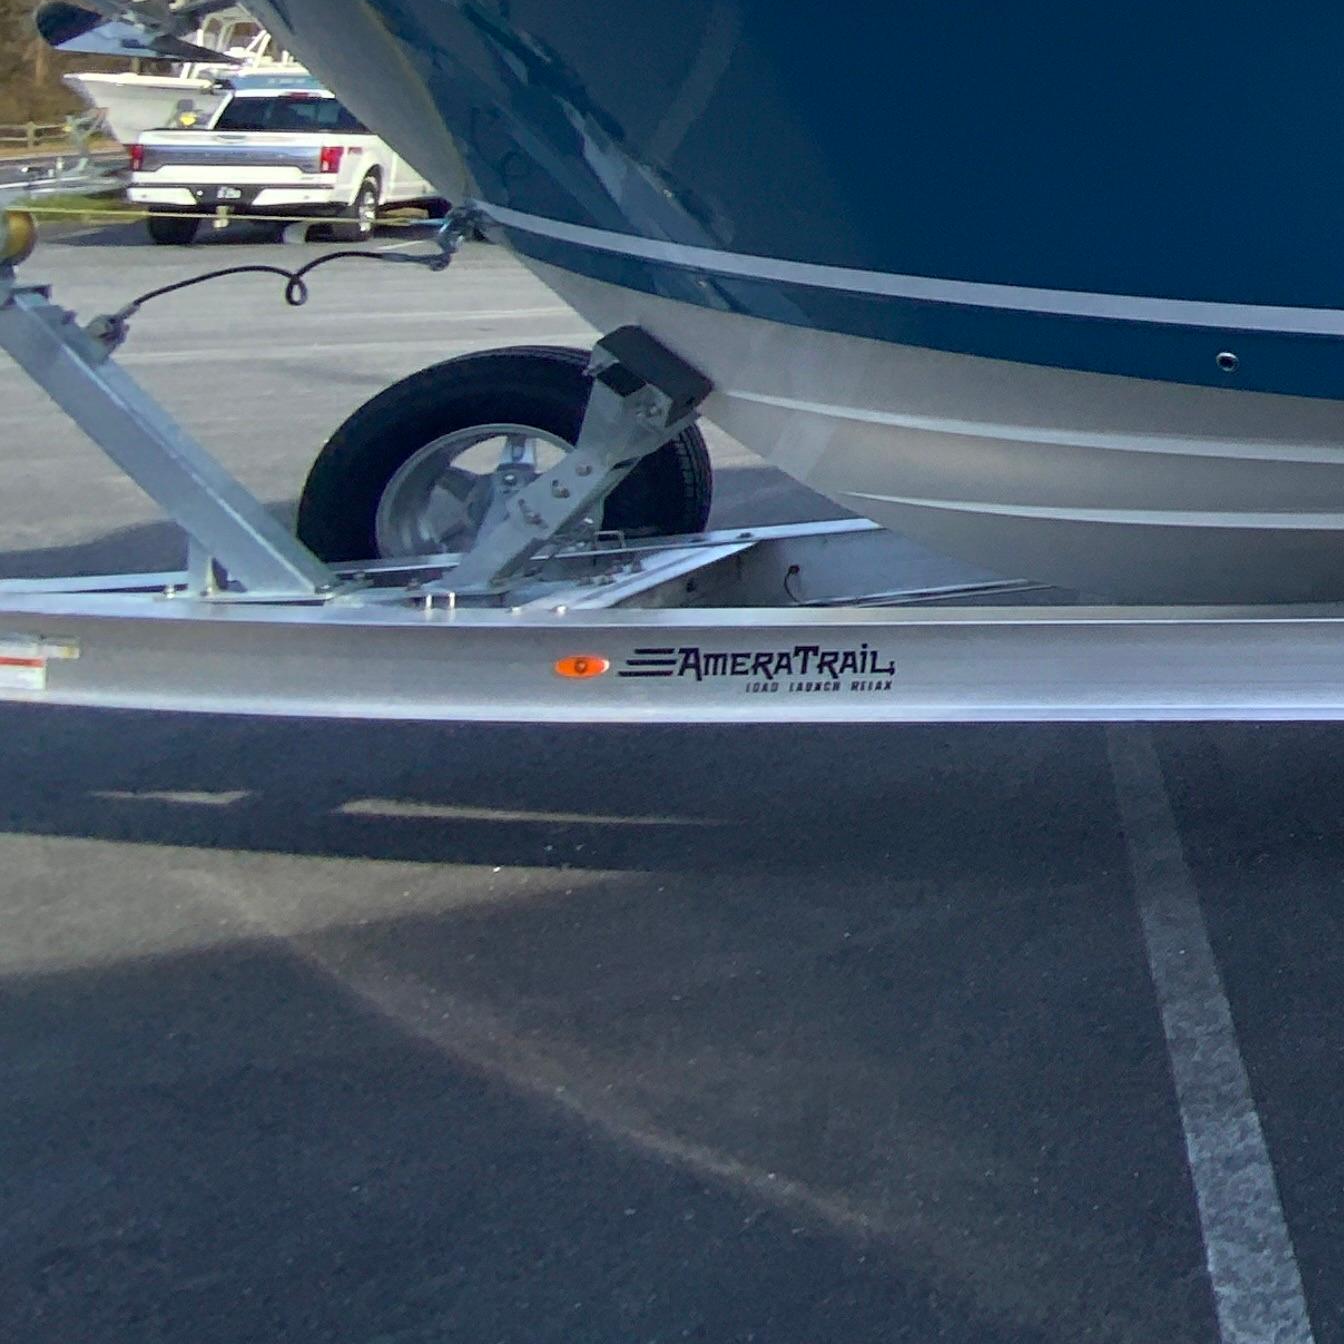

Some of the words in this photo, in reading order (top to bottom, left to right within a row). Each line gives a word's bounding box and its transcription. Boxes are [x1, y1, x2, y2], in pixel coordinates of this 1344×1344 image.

[745, 681, 780, 694] LOAD
[788, 681, 841, 693] LAUNCH
[850, 680, 894, 692] RELAX
